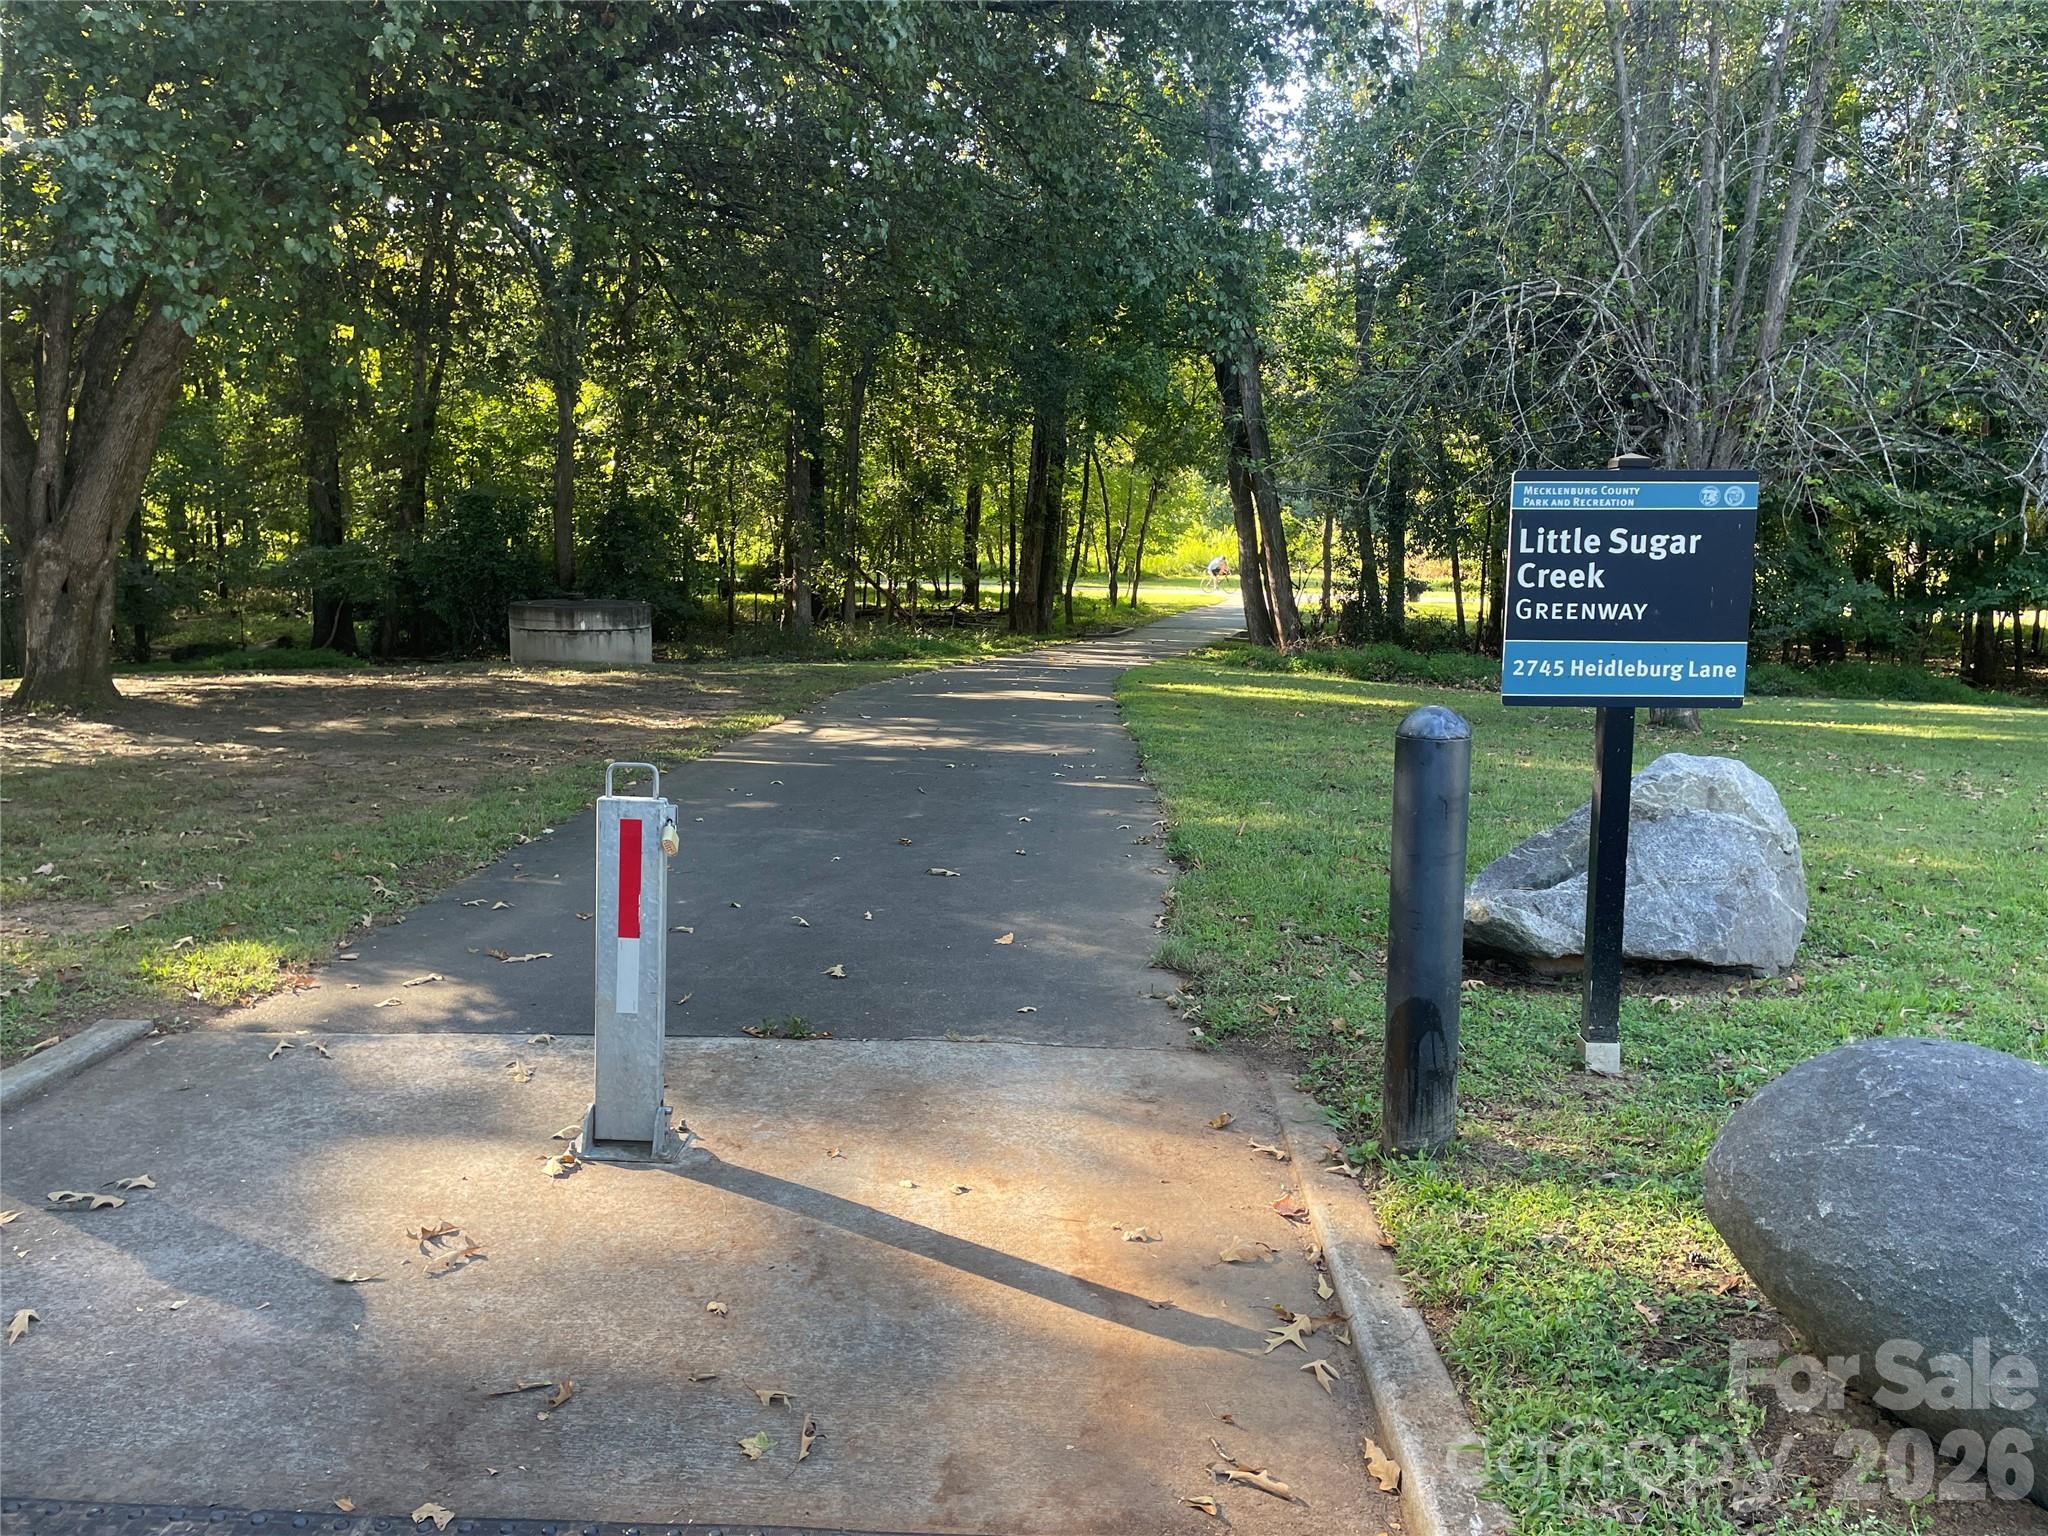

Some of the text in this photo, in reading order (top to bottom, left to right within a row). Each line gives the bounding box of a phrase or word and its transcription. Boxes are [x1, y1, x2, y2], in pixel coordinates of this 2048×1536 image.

[1519, 527, 1702, 560] Little Sugar
[1517, 562, 1605, 588] Creek
[1513, 659, 1737, 682] 2745 Heidleburg Lane
